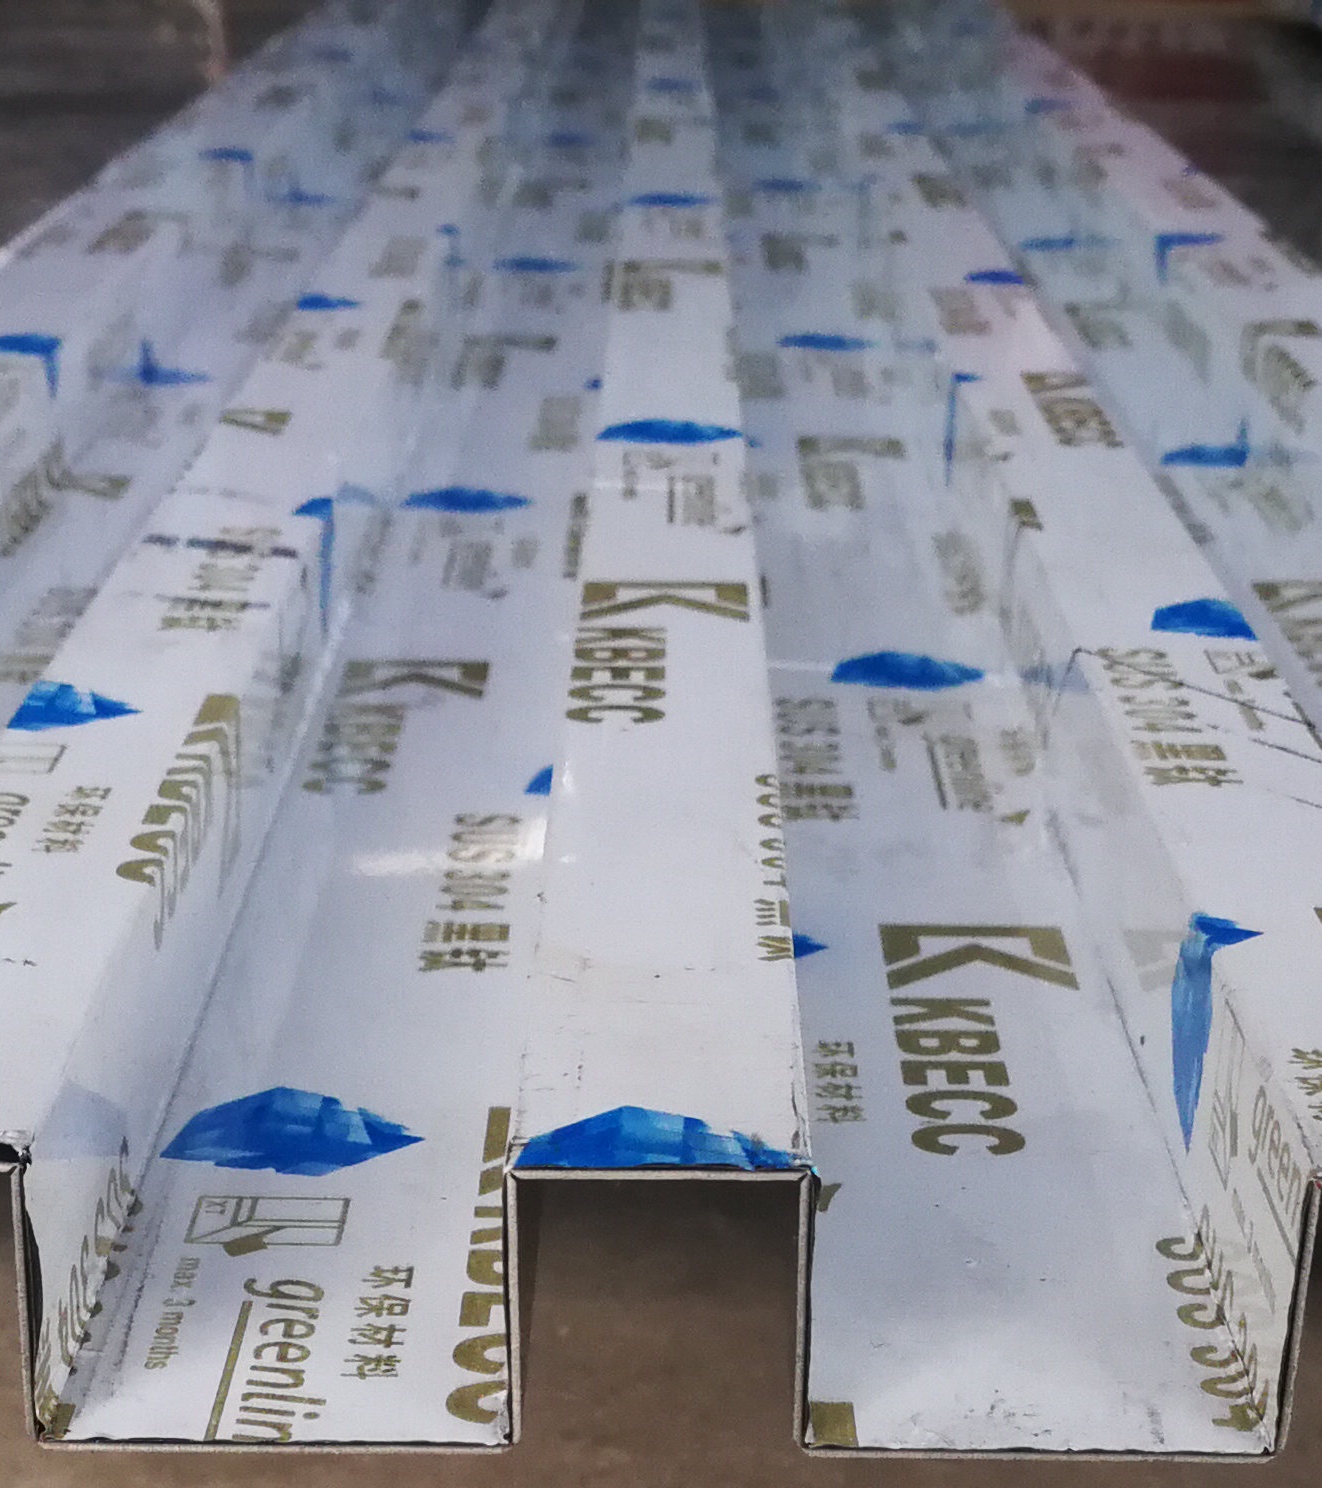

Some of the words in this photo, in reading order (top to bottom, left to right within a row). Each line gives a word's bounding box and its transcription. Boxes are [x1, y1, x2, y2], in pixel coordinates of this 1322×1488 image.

[565, 627, 668, 724] KBECC
[888, 996, 1027, 1157] KBECC
[230, 1278, 327, 1442] greenlin
[339, 1264, 416, 1380] 环保材料
